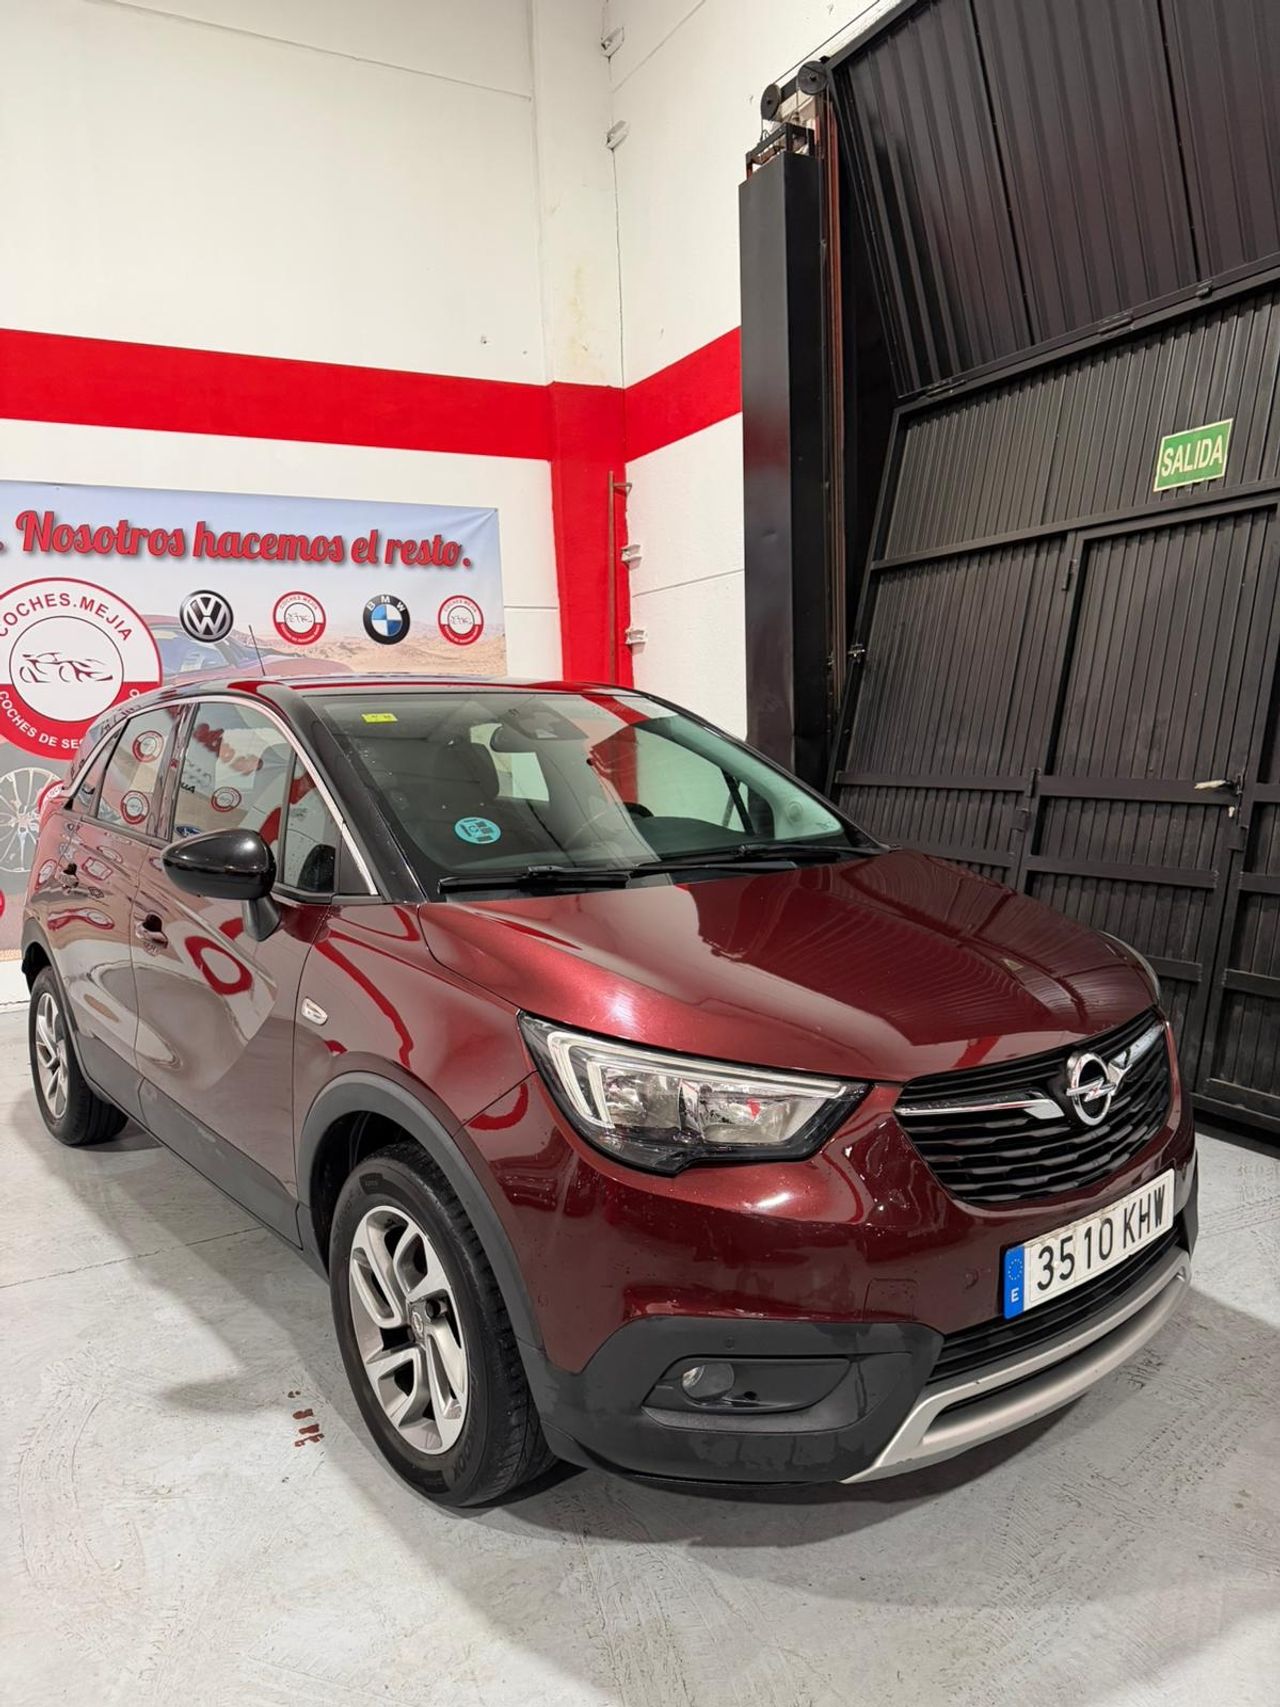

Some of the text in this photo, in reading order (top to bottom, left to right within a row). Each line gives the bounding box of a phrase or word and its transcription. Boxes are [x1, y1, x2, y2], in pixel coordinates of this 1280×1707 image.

[1161, 434, 1223, 477] SALIDA
[15, 510, 472, 567] Nosotros hacemos el resto.
[366, 595, 406, 612] BMW
[38, 733, 57, 747] DE
[1036, 1183, 1166, 1291] 3510 KHW
[1011, 1287, 1020, 1303] E
